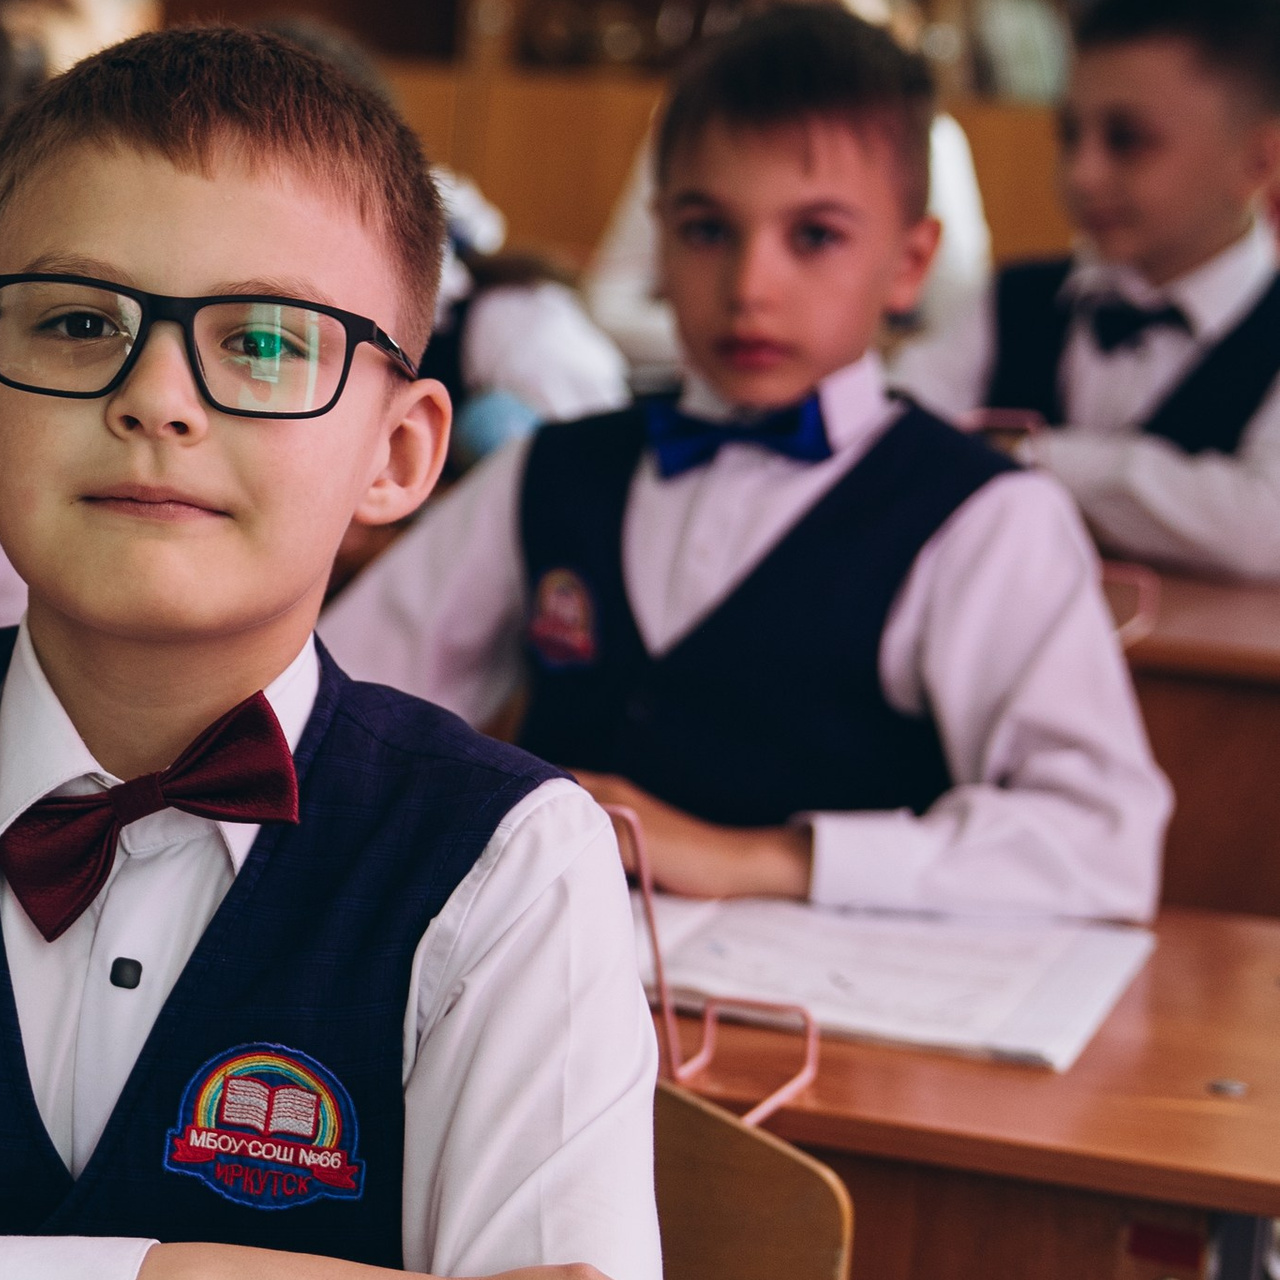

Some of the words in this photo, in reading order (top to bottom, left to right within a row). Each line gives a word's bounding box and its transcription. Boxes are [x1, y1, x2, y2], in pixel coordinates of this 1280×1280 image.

[189, 1128, 246, 1154] МБОУ
[248, 1140, 294, 1163] СОШ
[299, 1148, 342, 1169] №66
[215, 1162, 312, 1197] ИРКУТСК
